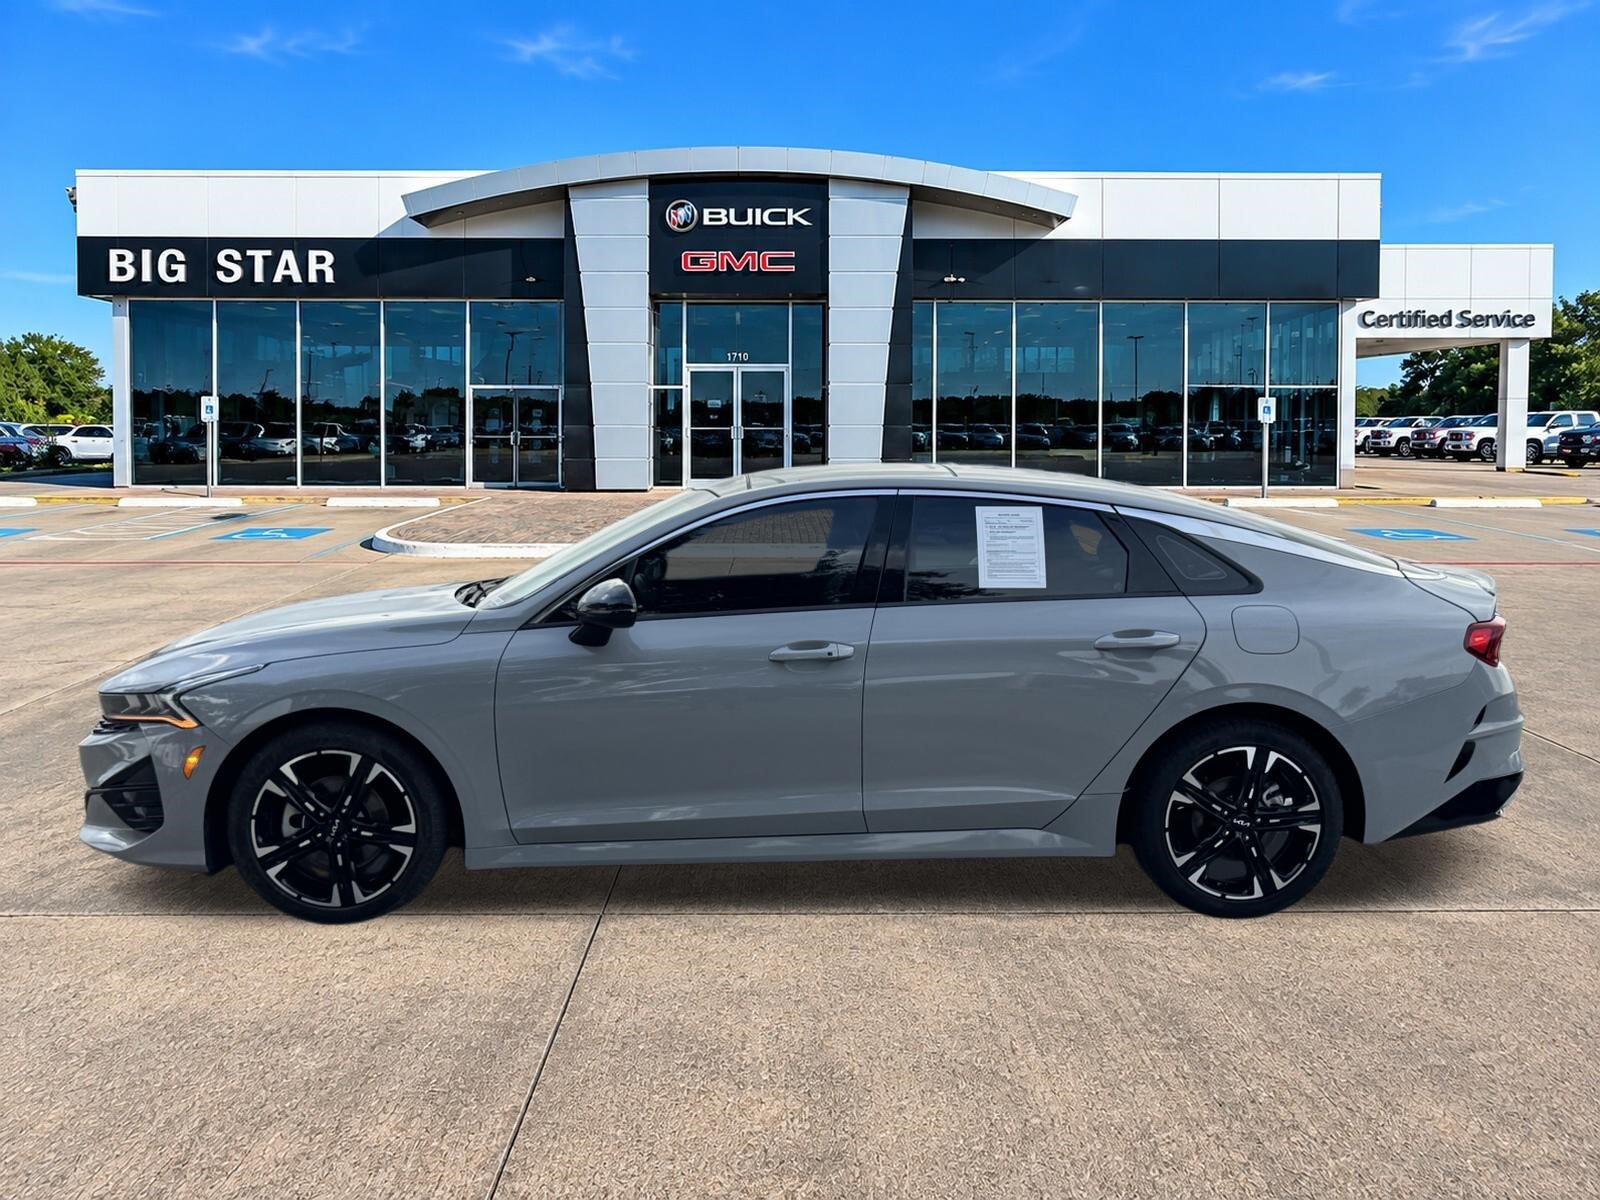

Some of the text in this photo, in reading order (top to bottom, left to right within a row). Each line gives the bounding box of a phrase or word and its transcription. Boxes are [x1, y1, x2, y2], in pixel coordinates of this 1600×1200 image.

[703, 208, 813, 226] BUICK
[108, 248, 336, 284] BIG STAR
[681, 251, 796, 272] GMC
[1359, 309, 1536, 328] Certified Service
[727, 352, 749, 361] 1710
